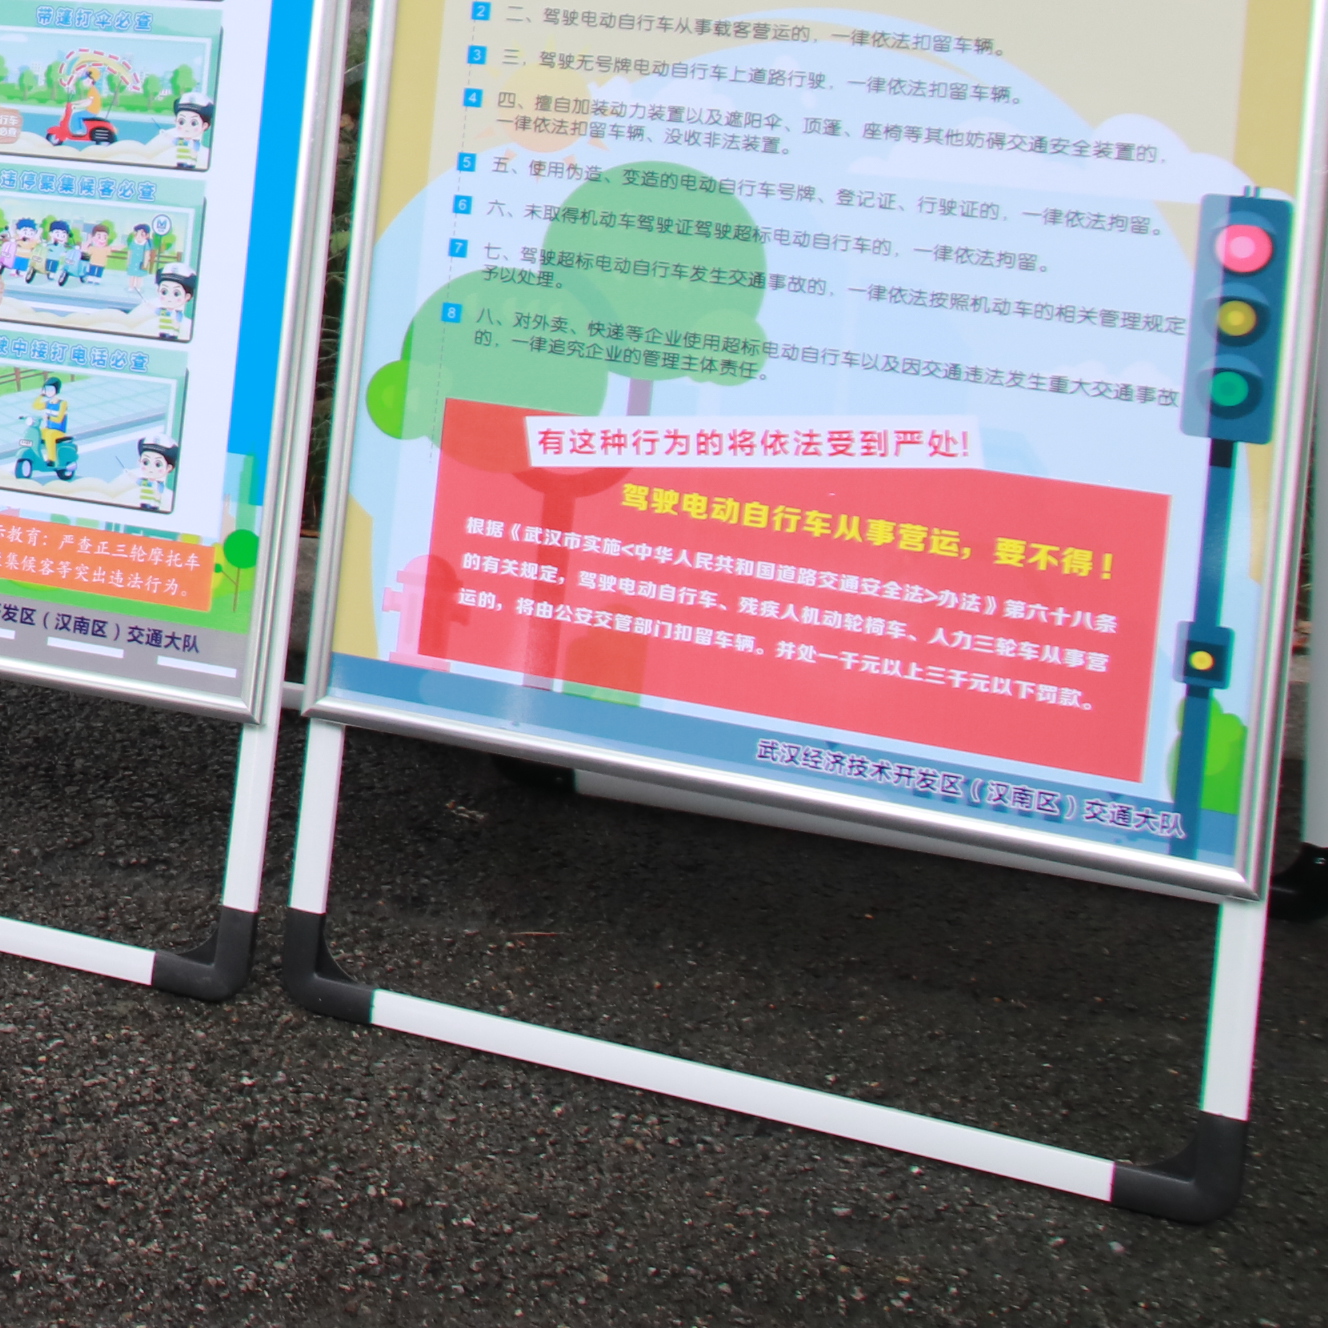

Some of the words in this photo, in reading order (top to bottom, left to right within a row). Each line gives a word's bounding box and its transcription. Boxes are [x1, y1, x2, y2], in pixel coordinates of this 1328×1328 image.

[476, 6, 486, 17] 2
[473, 49, 482, 61] 3
[467, 92, 477, 104] 4
[462, 157, 471, 169] 5
[0, 169, 157, 202] 违停聚集候客必查
[458, 199, 467, 211] 6
[454, 242, 463, 254] 7
[482, 264, 563, 290] 予以处理。
[447, 307, 457, 319] 8
